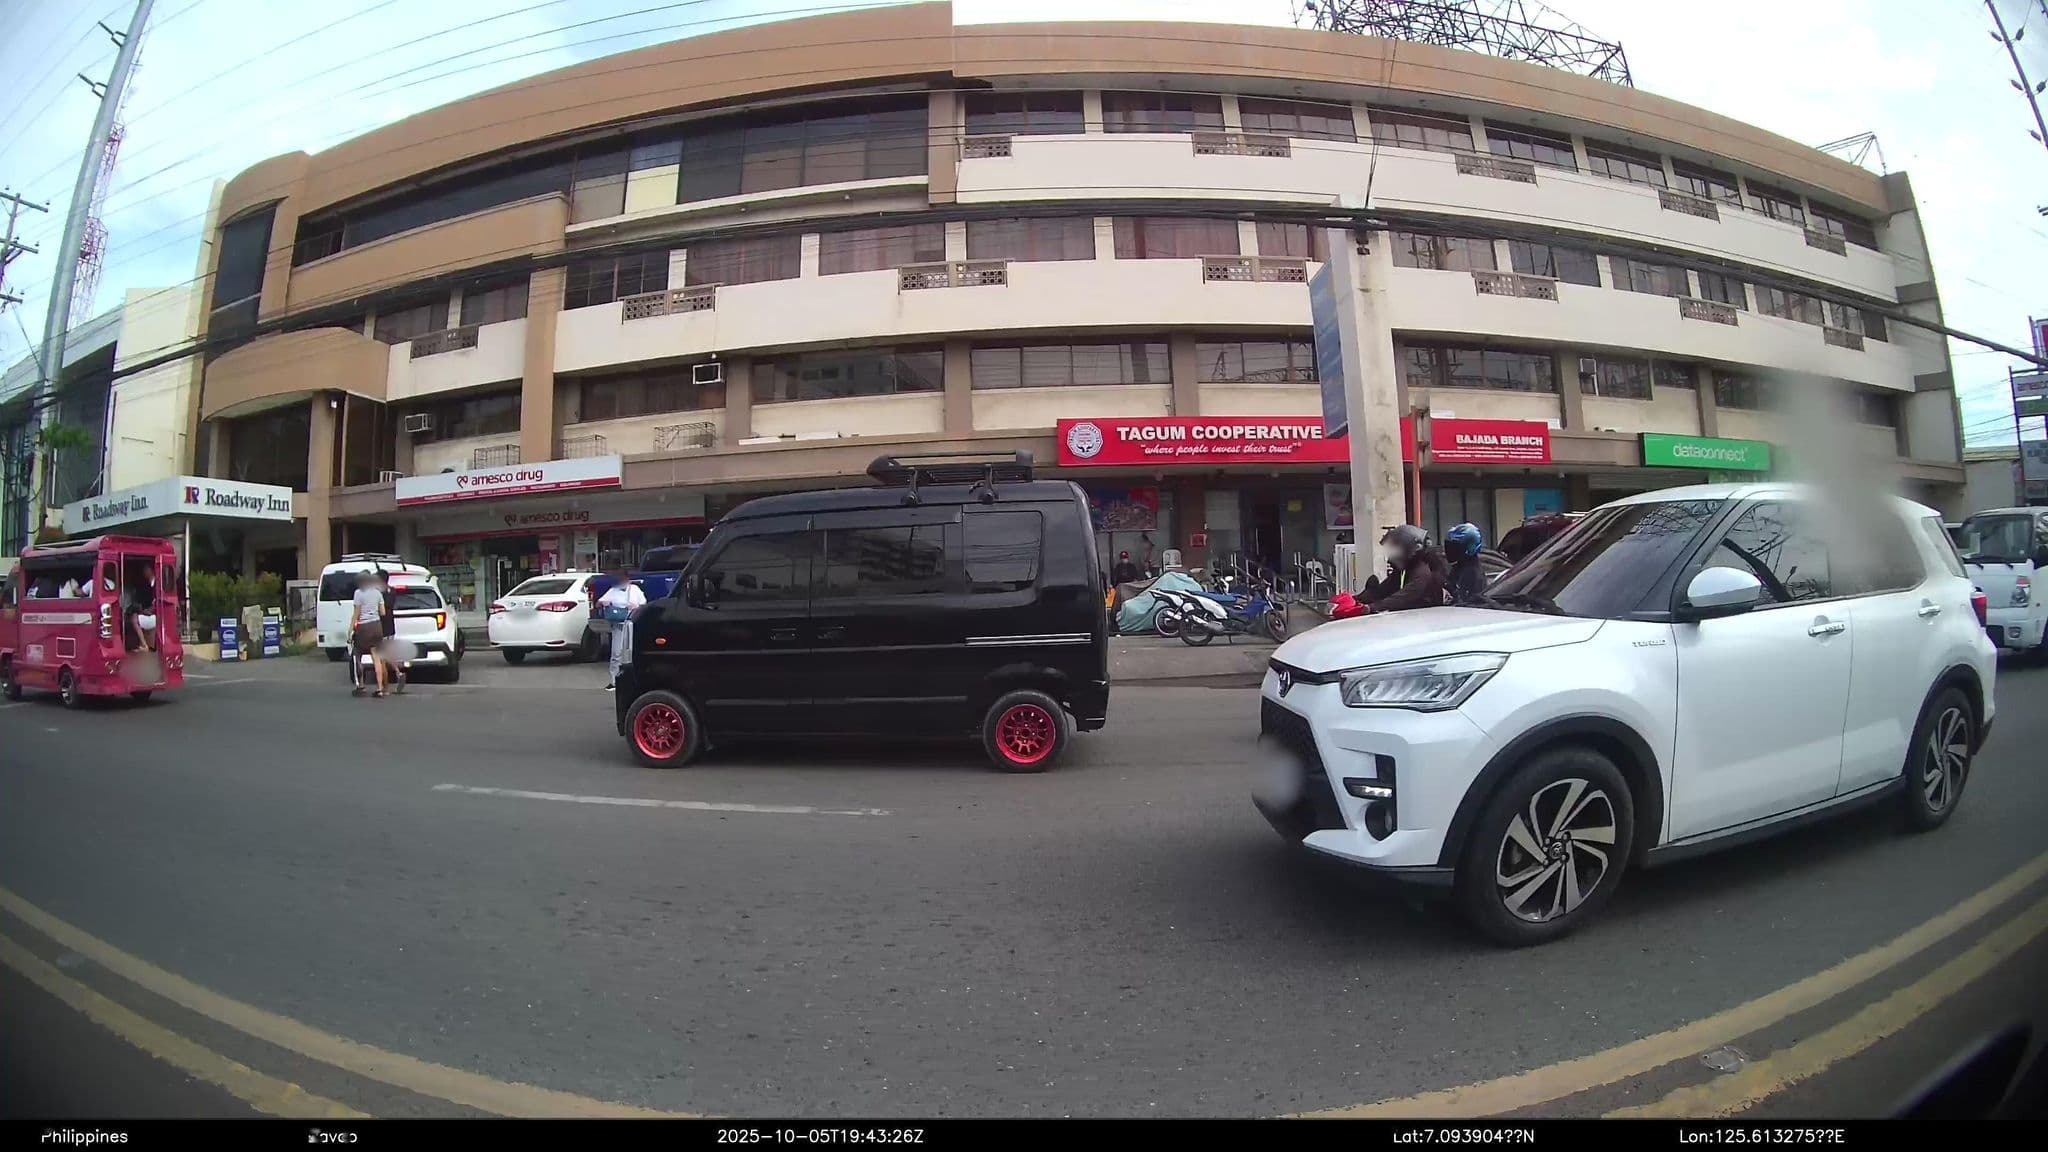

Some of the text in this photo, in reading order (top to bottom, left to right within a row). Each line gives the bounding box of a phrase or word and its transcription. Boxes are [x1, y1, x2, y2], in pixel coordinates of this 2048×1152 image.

[1117, 426, 1186, 441] TAGUM
[1191, 425, 1322, 440] COOPERATIVE
[1456, 434, 1543, 446] BAJADA BRANCH
[1176, 443, 1209, 456] people
[1211, 443, 1241, 453] invest
[1242, 441, 1267, 453] their
[471, 469, 543, 486] amesco drug
[92, 494, 148, 520] Roadway Inn
[205, 488, 290, 513] Roadway Inn
[562, 509, 590, 522] drug
